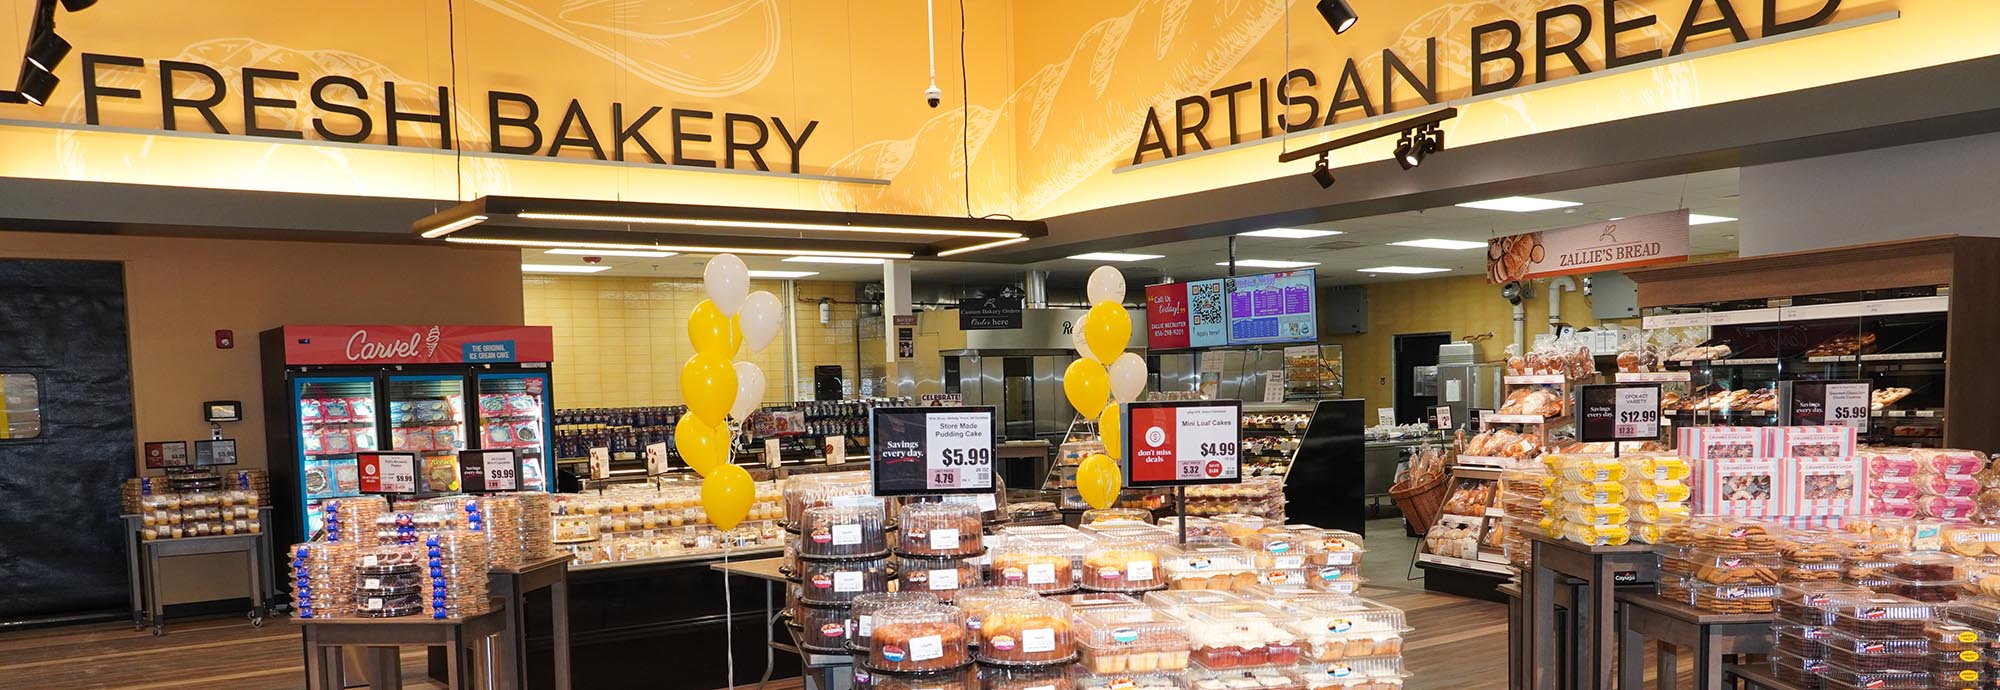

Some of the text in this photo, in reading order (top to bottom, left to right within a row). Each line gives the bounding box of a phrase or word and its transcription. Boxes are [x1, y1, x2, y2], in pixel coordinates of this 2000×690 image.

[1132, 37, 1441, 165] ARTISAN
[81, 52, 820, 174] FRESH BAKERY
[1560, 242, 1661, 267] ZALLIE'S BREAD
[1158, 300, 1181, 316] today!
[971, 318, 992, 326] Order
[346, 329, 421, 361] Carvel
[482, 344, 505, 352] ORIGINAL
[496, 351, 510, 359] CAKE
[1621, 410, 1656, 423] $12.99
[1835, 406, 1867, 419] $5.99
[939, 422, 978, 430] Store Made
[965, 430, 983, 438] Cake
[887, 440, 919, 450] Savings
[1200, 442, 1235, 457] $4.99
[882, 449, 924, 459] every day.
[942, 448, 989, 467] $5.99
[1137, 449, 1155, 457] don't
[491, 469, 514, 479] $9.99
[1183, 466, 1199, 474] 5.32
[396, 475, 413, 483] $9.99
[934, 473, 954, 484] 4.79
